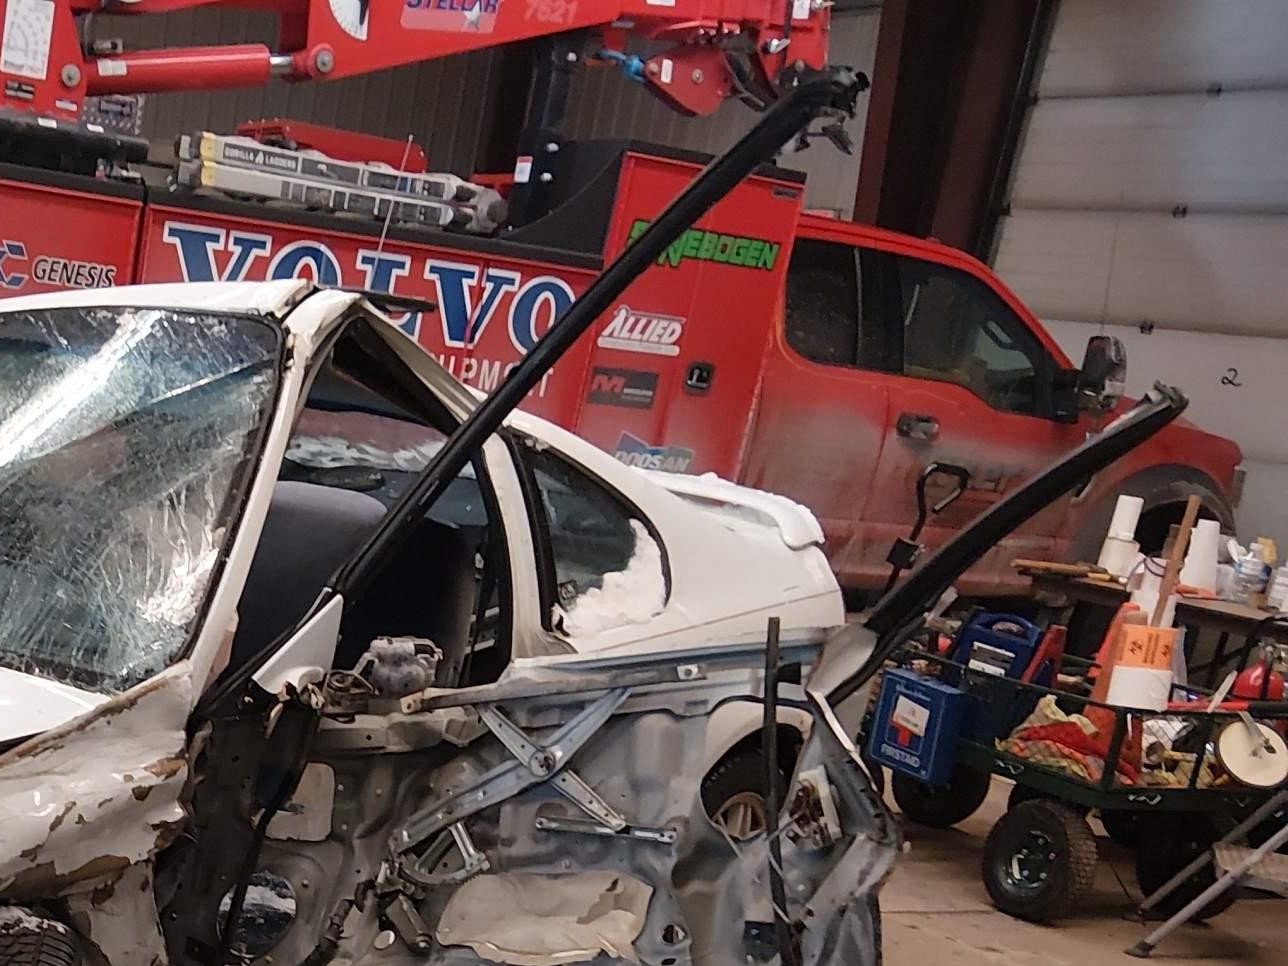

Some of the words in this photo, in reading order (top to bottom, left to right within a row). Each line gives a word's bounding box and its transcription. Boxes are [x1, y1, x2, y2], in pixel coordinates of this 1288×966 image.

[32, 256, 116, 288] GENESIS
[601, 308, 682, 344] ALLIED
[1221, 367, 1243, 387] 2
[614, 450, 690, 473] DOOSAN
